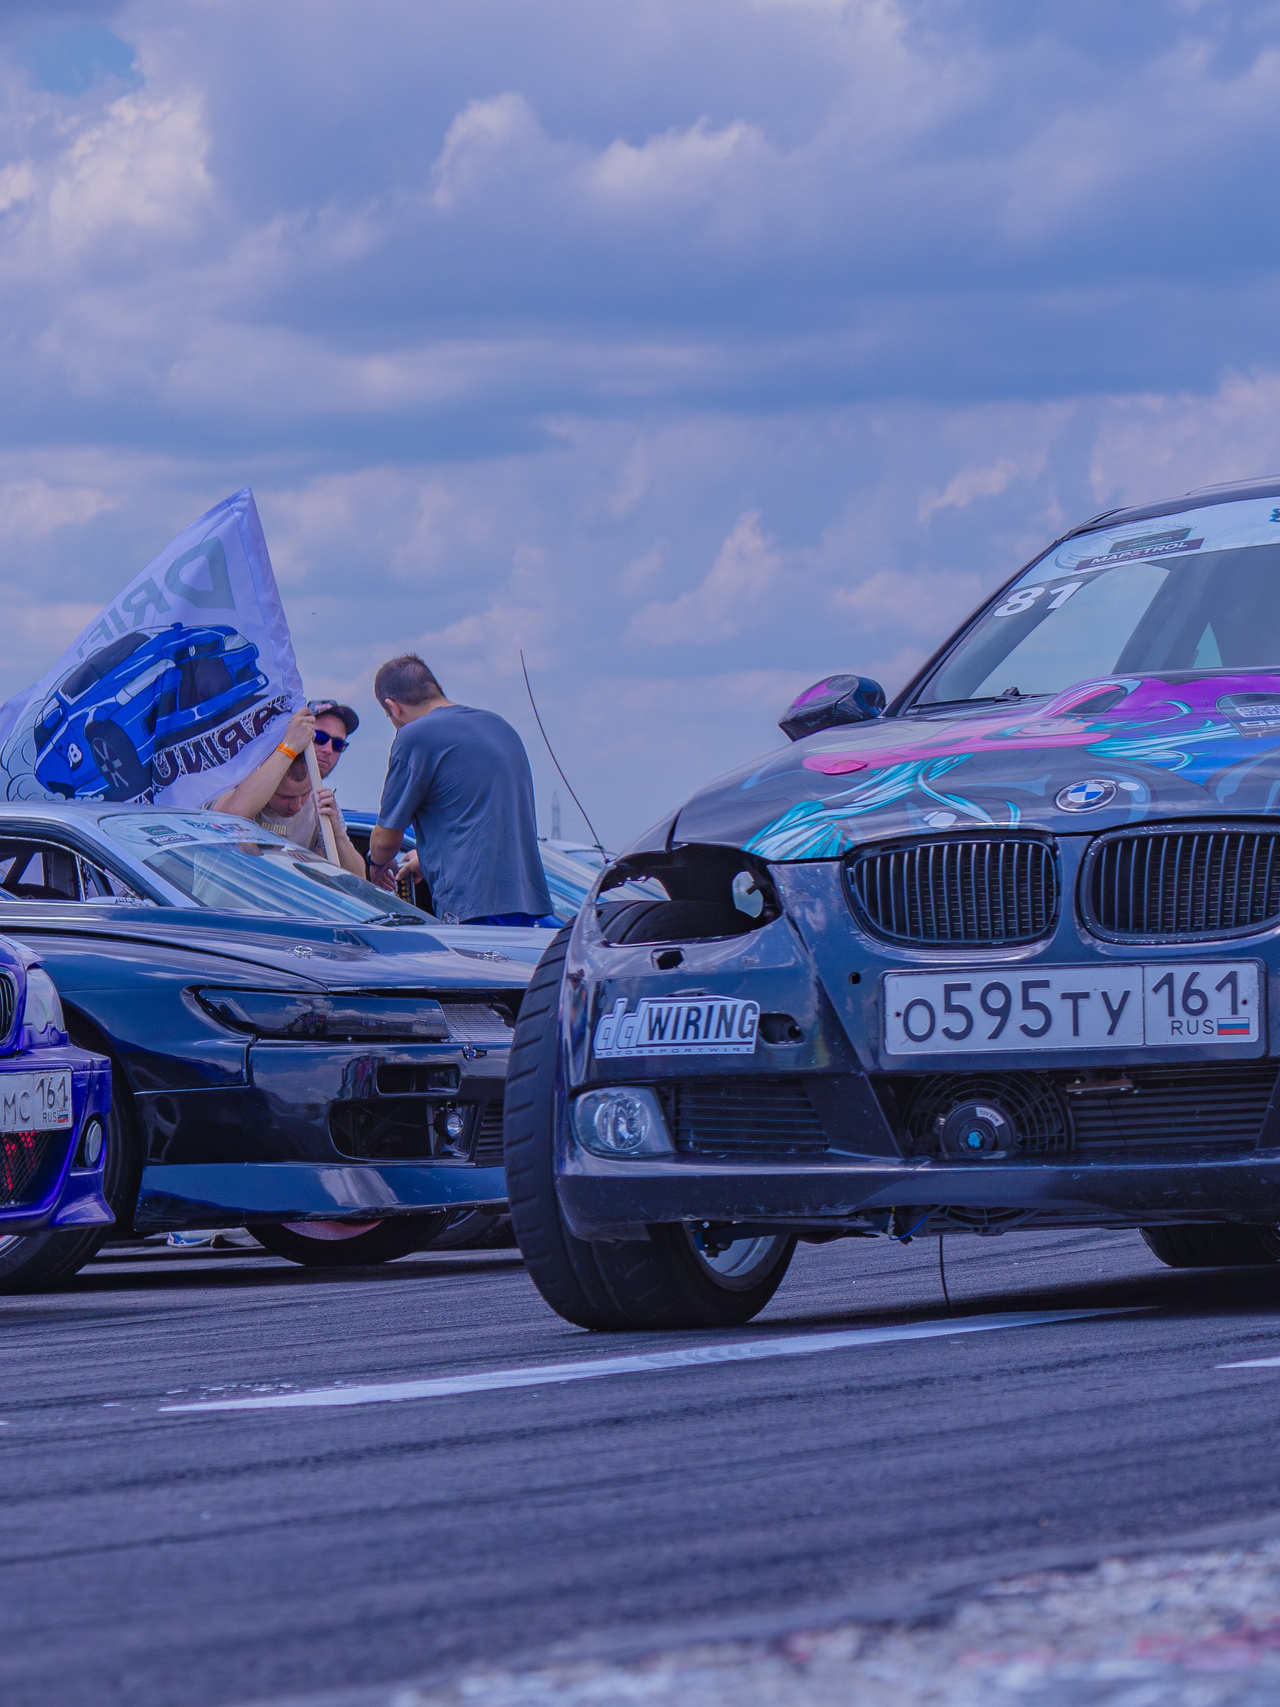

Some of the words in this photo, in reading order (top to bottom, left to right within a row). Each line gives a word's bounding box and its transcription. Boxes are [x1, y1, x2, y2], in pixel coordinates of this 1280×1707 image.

[994, 581, 1084, 617] 81
[1152, 970, 1238, 1017] 161
[1171, 1019, 1216, 1036] RUS
[36, 1075, 67, 1110] 161
[42, 1112, 58, 1124] RUS
